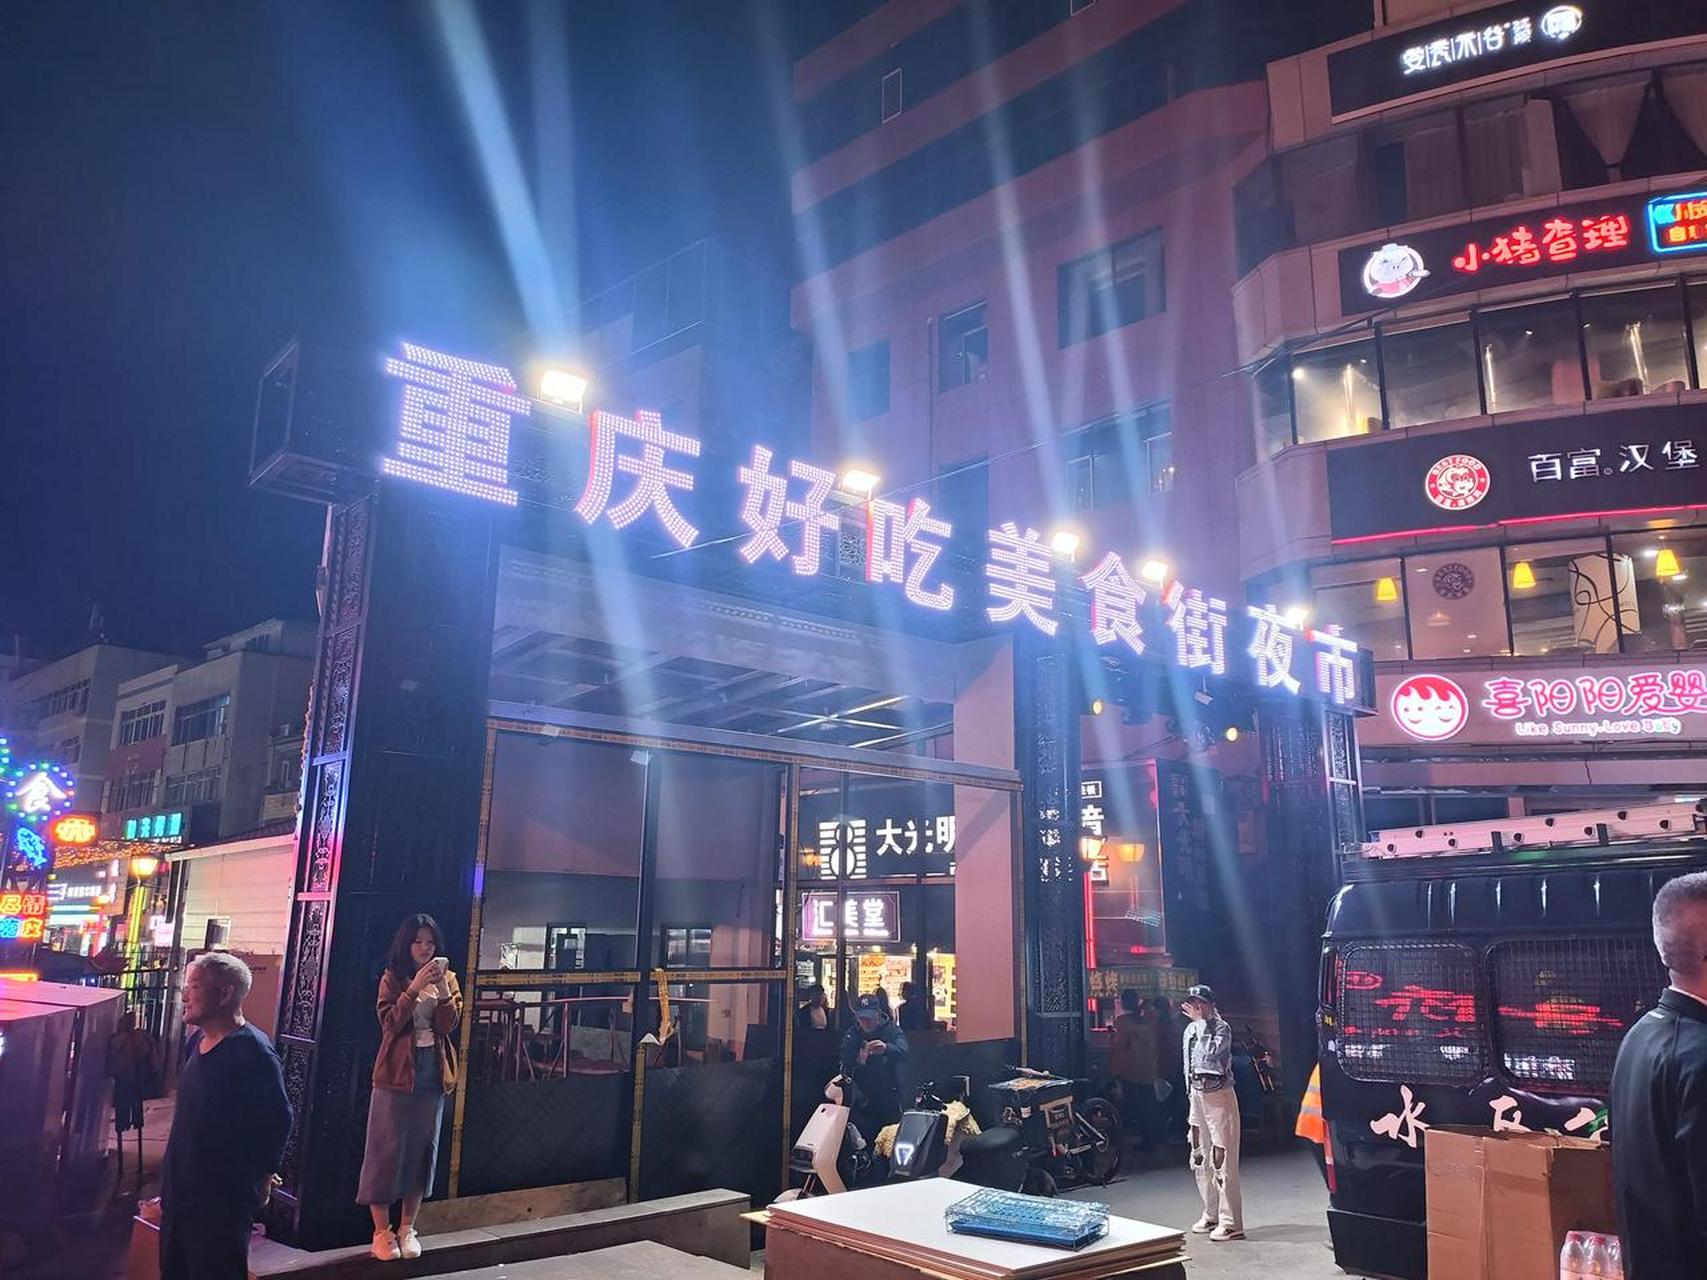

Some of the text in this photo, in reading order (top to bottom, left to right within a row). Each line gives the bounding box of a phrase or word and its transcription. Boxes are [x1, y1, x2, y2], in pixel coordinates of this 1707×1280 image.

[1453, 215, 1629, 272] 小猪查理
[384, 341, 1358, 704] 重庆好吃美食街夜市
[1481, 670, 1707, 720] 喜阳阳爱婴
[1515, 722, 1549, 736] Like
